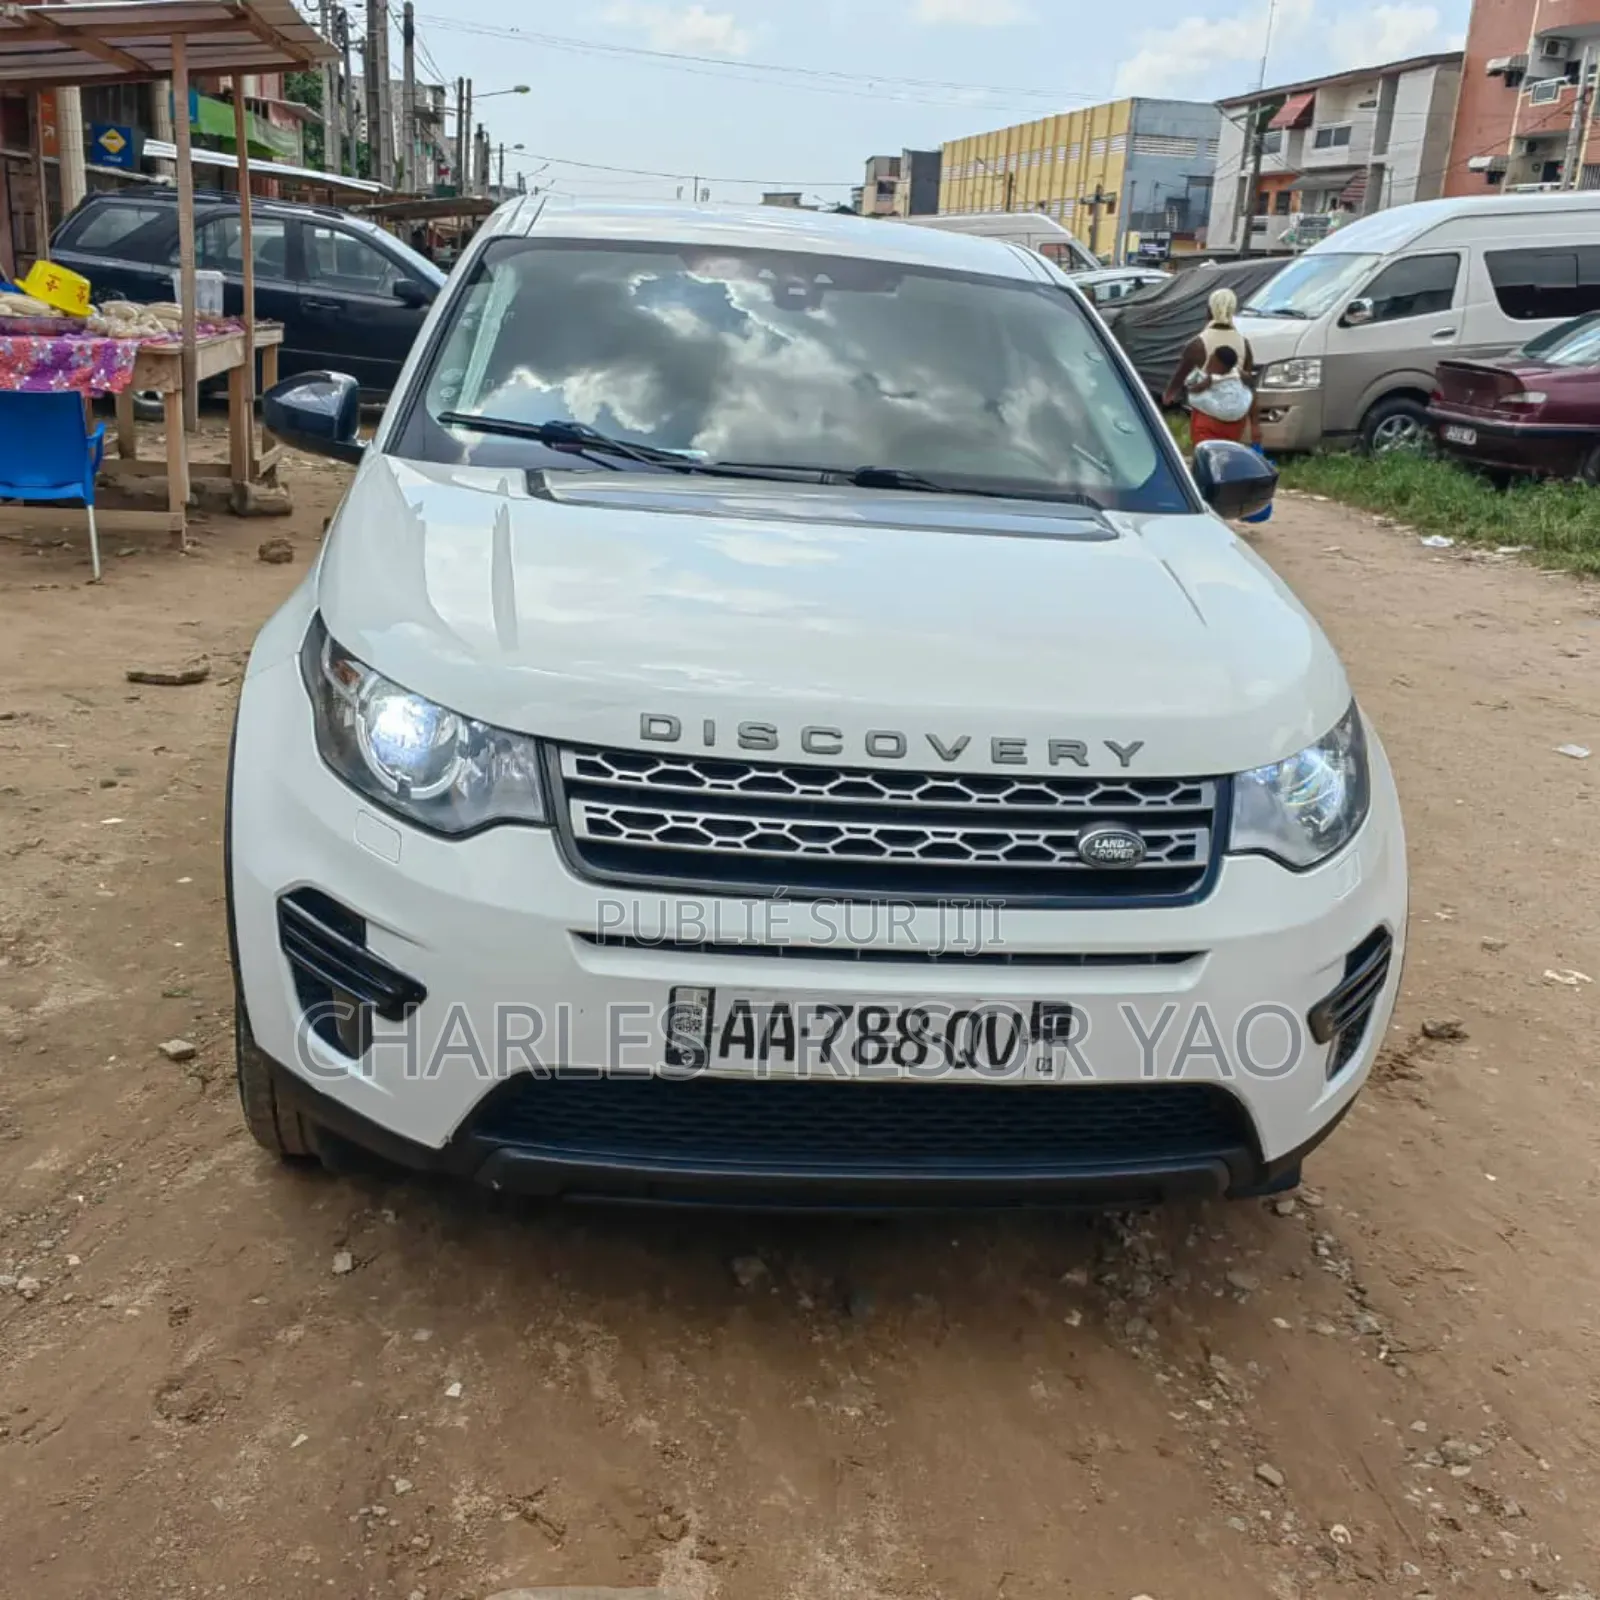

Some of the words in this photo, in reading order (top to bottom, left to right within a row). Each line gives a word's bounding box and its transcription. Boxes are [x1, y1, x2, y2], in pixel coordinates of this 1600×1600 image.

[640, 712, 1145, 768] DISCOVERY
[1094, 839, 1125, 849] LAND
[1098, 848, 1134, 859] ROVER
